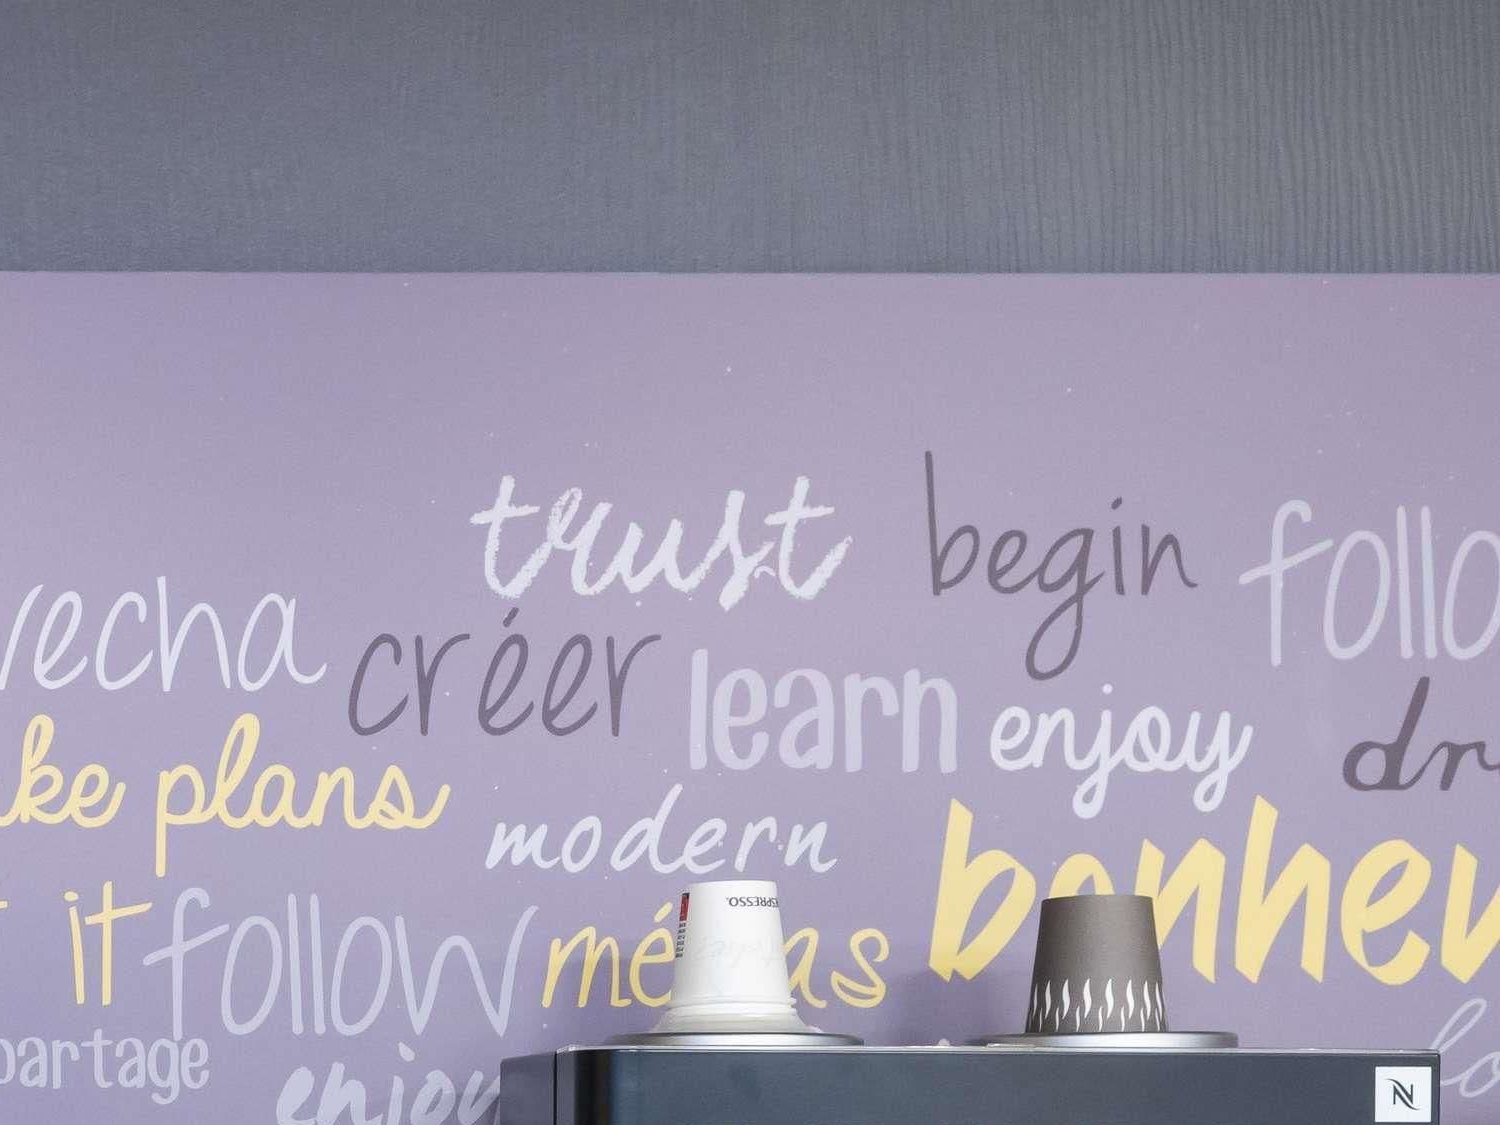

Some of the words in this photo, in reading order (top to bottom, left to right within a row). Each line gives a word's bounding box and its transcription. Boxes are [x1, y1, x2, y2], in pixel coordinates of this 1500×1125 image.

[470, 475, 852, 612] trust
[924, 450, 1199, 682] begin
[347, 607, 662, 738] créer
[689, 648, 959, 774] learn
[155, 713, 451, 878] plans
[989, 683, 1254, 820] enjoy
[484, 783, 838, 876] modern
[64, 880, 154, 1006] it
[142, 887, 541, 1038] follow
